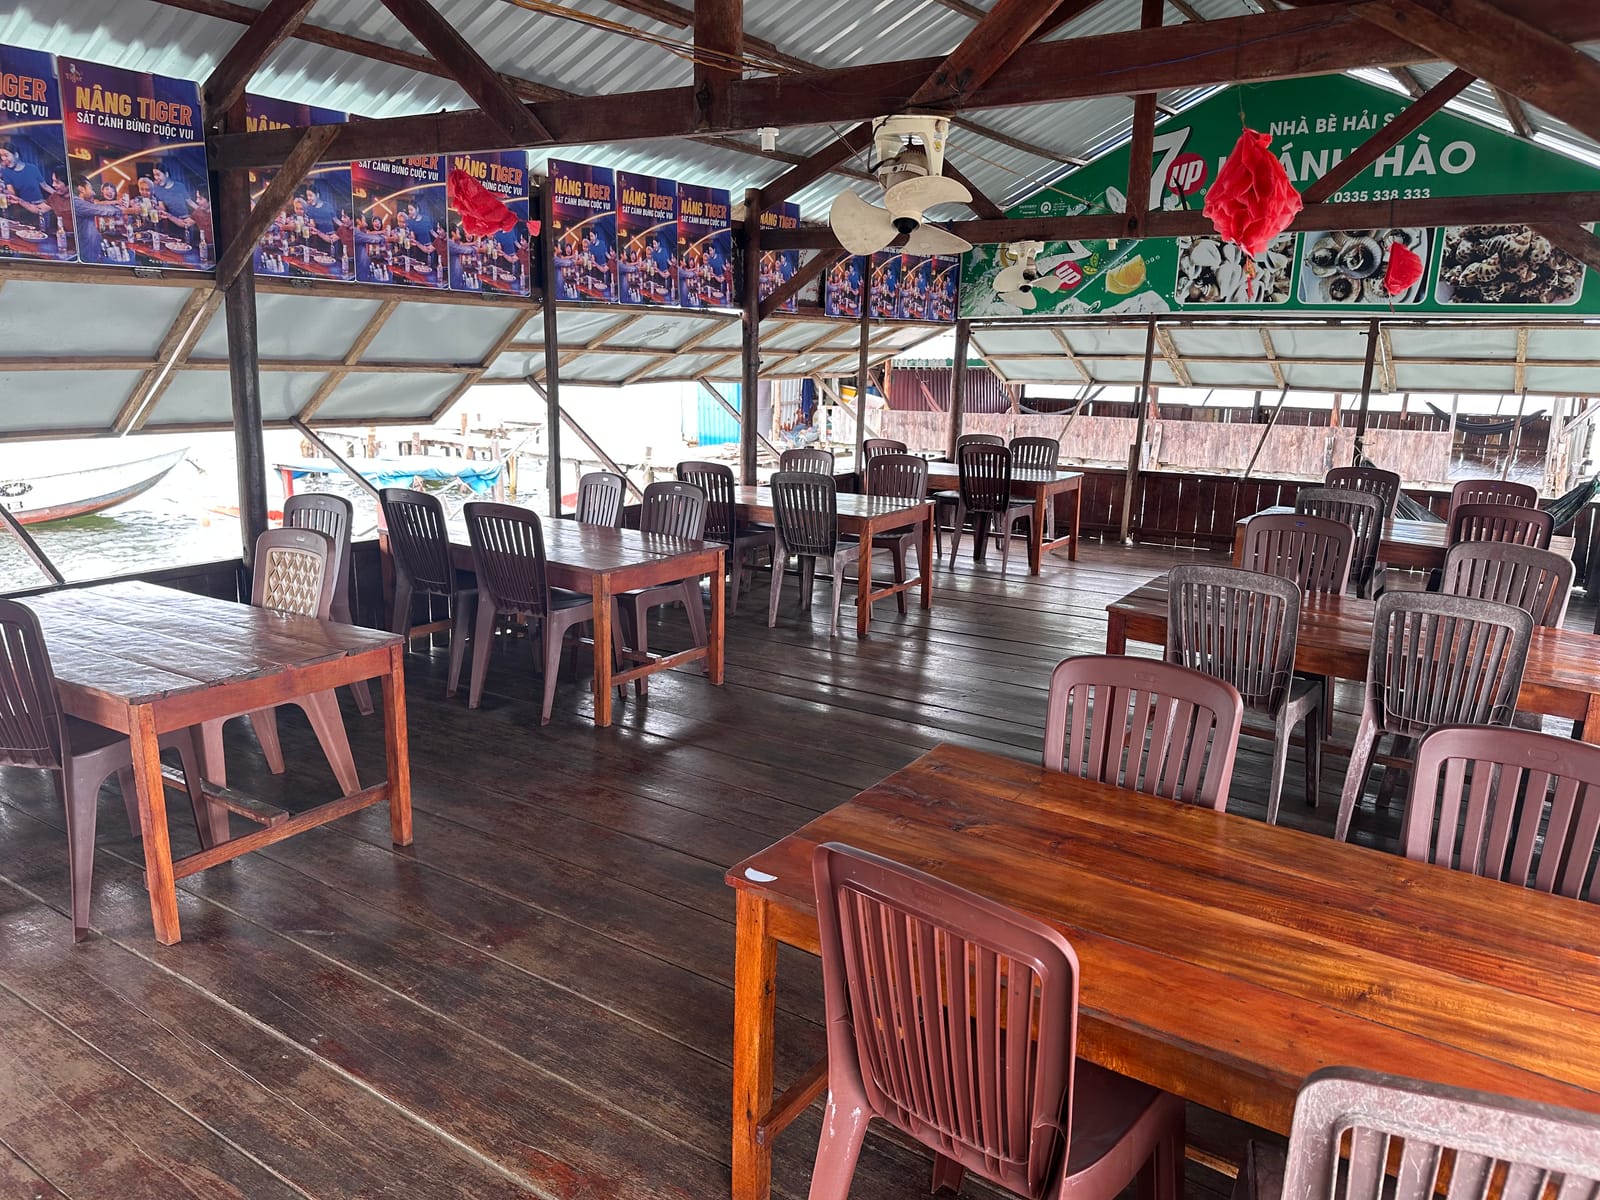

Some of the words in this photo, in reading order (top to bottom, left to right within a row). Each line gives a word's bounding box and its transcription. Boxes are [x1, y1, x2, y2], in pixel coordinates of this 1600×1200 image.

[31, 104, 48, 117] VUI
[76, 84, 132, 116] NÂNG
[136, 97, 192, 126] TIGER
[77, 111, 96, 125] SÁT
[98, 115, 123, 129] CÁNH
[152, 124, 176, 139] CUỘC
[179, 128, 194, 140] VUI
[1269, 116, 1309, 136] NHÀ
[1315, 113, 1337, 134] BÈ
[1343, 109, 1377, 131] HẢI
[1374, 133, 1476, 178] HÀO
[428, 171, 438, 181] VUI
[490, 163, 523, 185] TIGER
[555, 176, 581, 196] NÂNG
[584, 183, 610, 201] TIGER
[622, 187, 646, 207] NÂNG
[649, 193, 673, 211] TIGER
[1334, 190, 1368, 203] 0335
[1372, 190, 1398, 201] 338
[1403, 188, 1430, 200] 333
[681, 197, 703, 216] NÂNG
[705, 203, 727, 219] TIGER
[779, 215, 797, 229] TIGER
